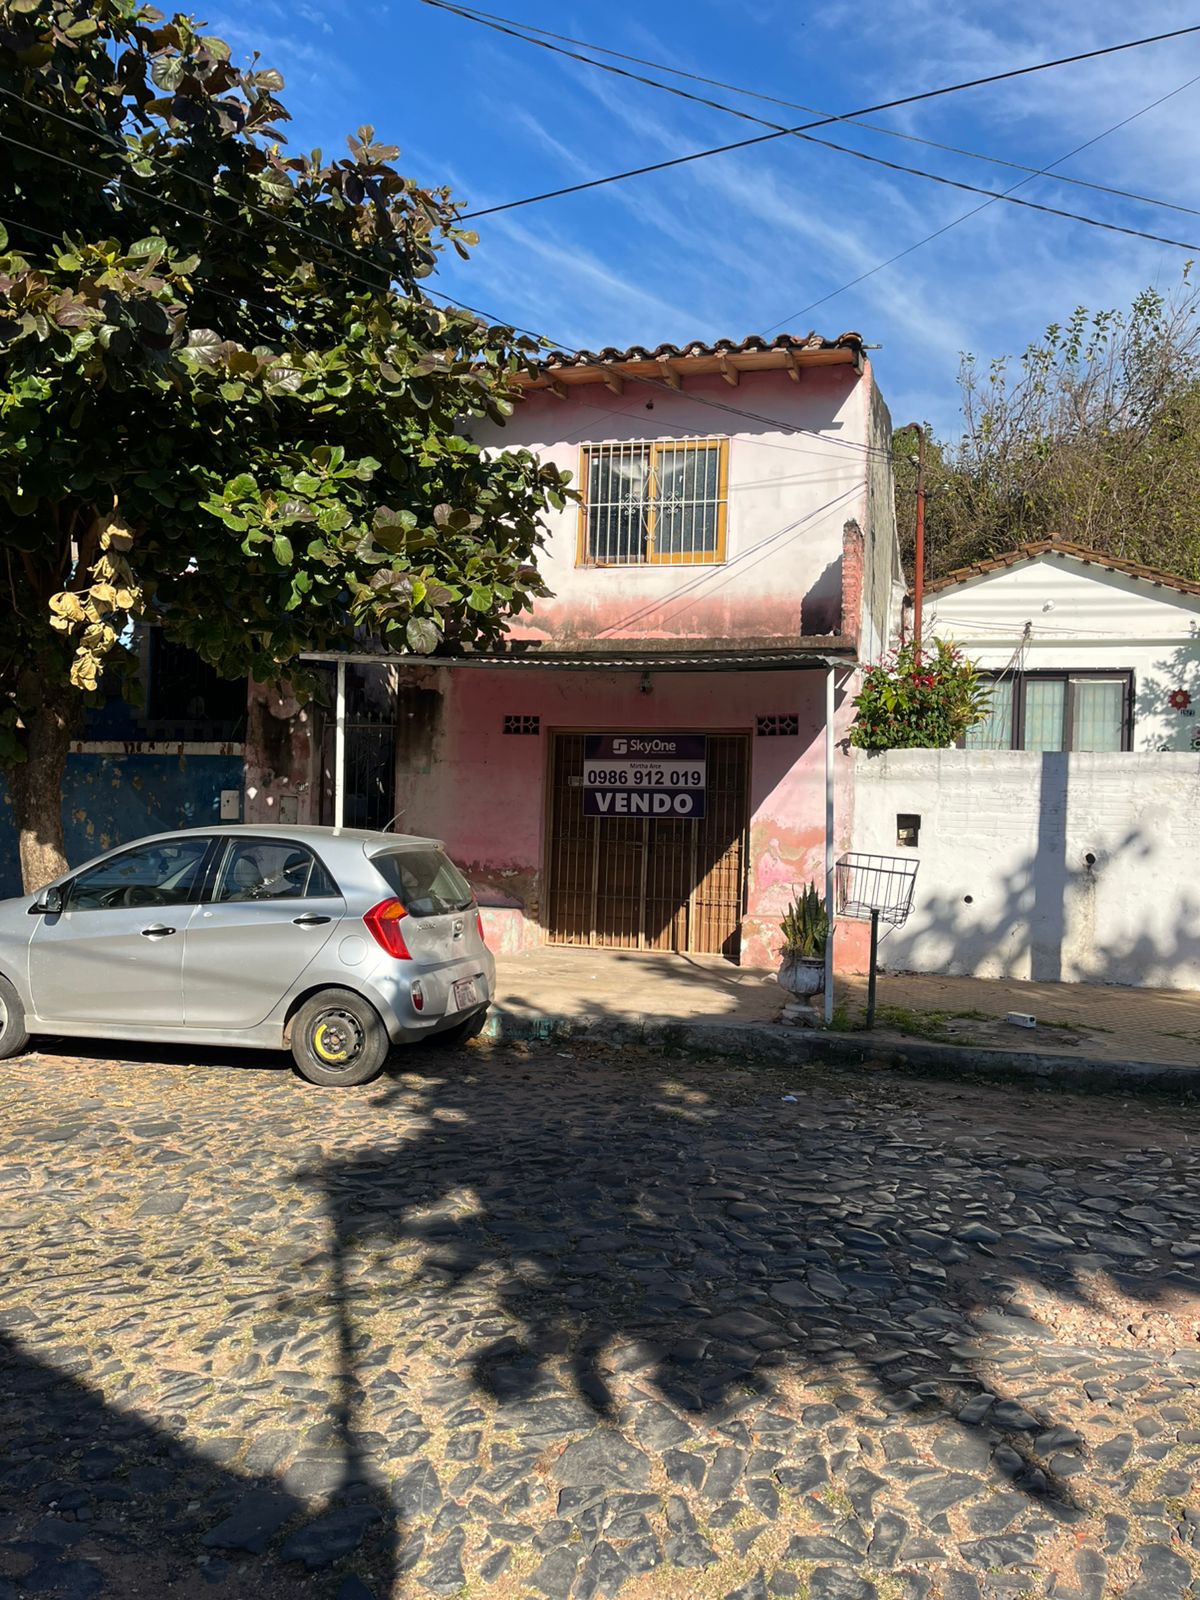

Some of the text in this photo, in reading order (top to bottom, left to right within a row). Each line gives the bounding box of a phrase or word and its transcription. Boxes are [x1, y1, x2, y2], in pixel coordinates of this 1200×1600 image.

[630, 739, 677, 754] SkyOne
[588, 770, 701, 785] 0986 912 019
[595, 792, 693, 814] VENDO
